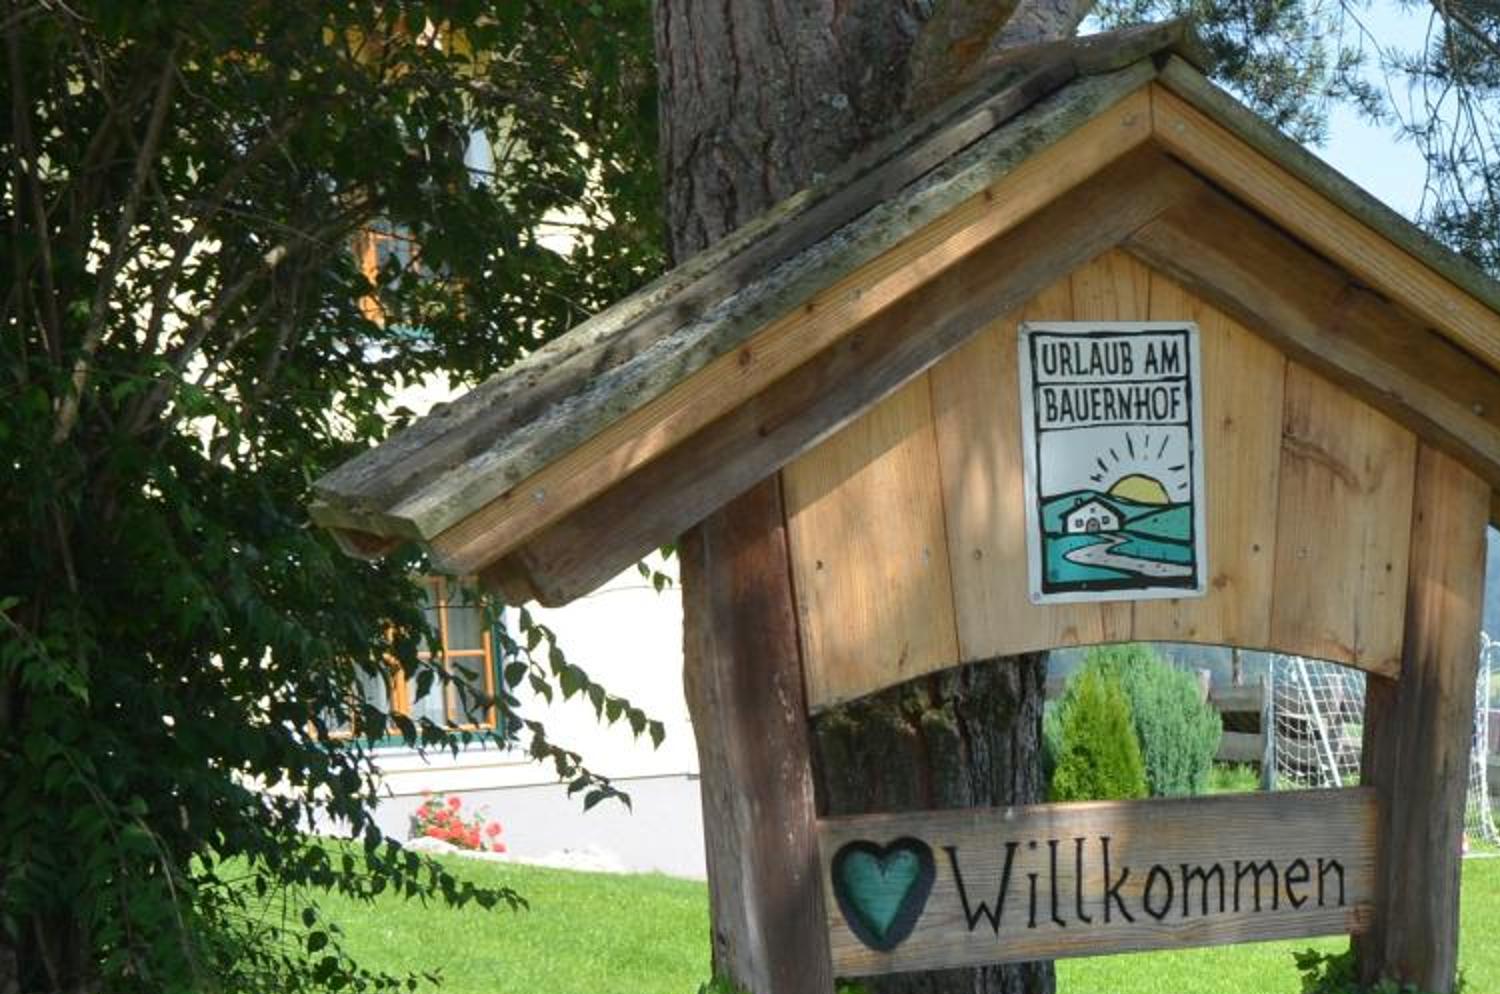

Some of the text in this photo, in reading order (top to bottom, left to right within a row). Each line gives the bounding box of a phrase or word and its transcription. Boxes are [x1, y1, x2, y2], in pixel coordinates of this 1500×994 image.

[1041, 340, 1180, 377] URLAUB AM
[1044, 386, 1181, 422] BAUERNHOF
[942, 836, 1347, 936] Willkommen
